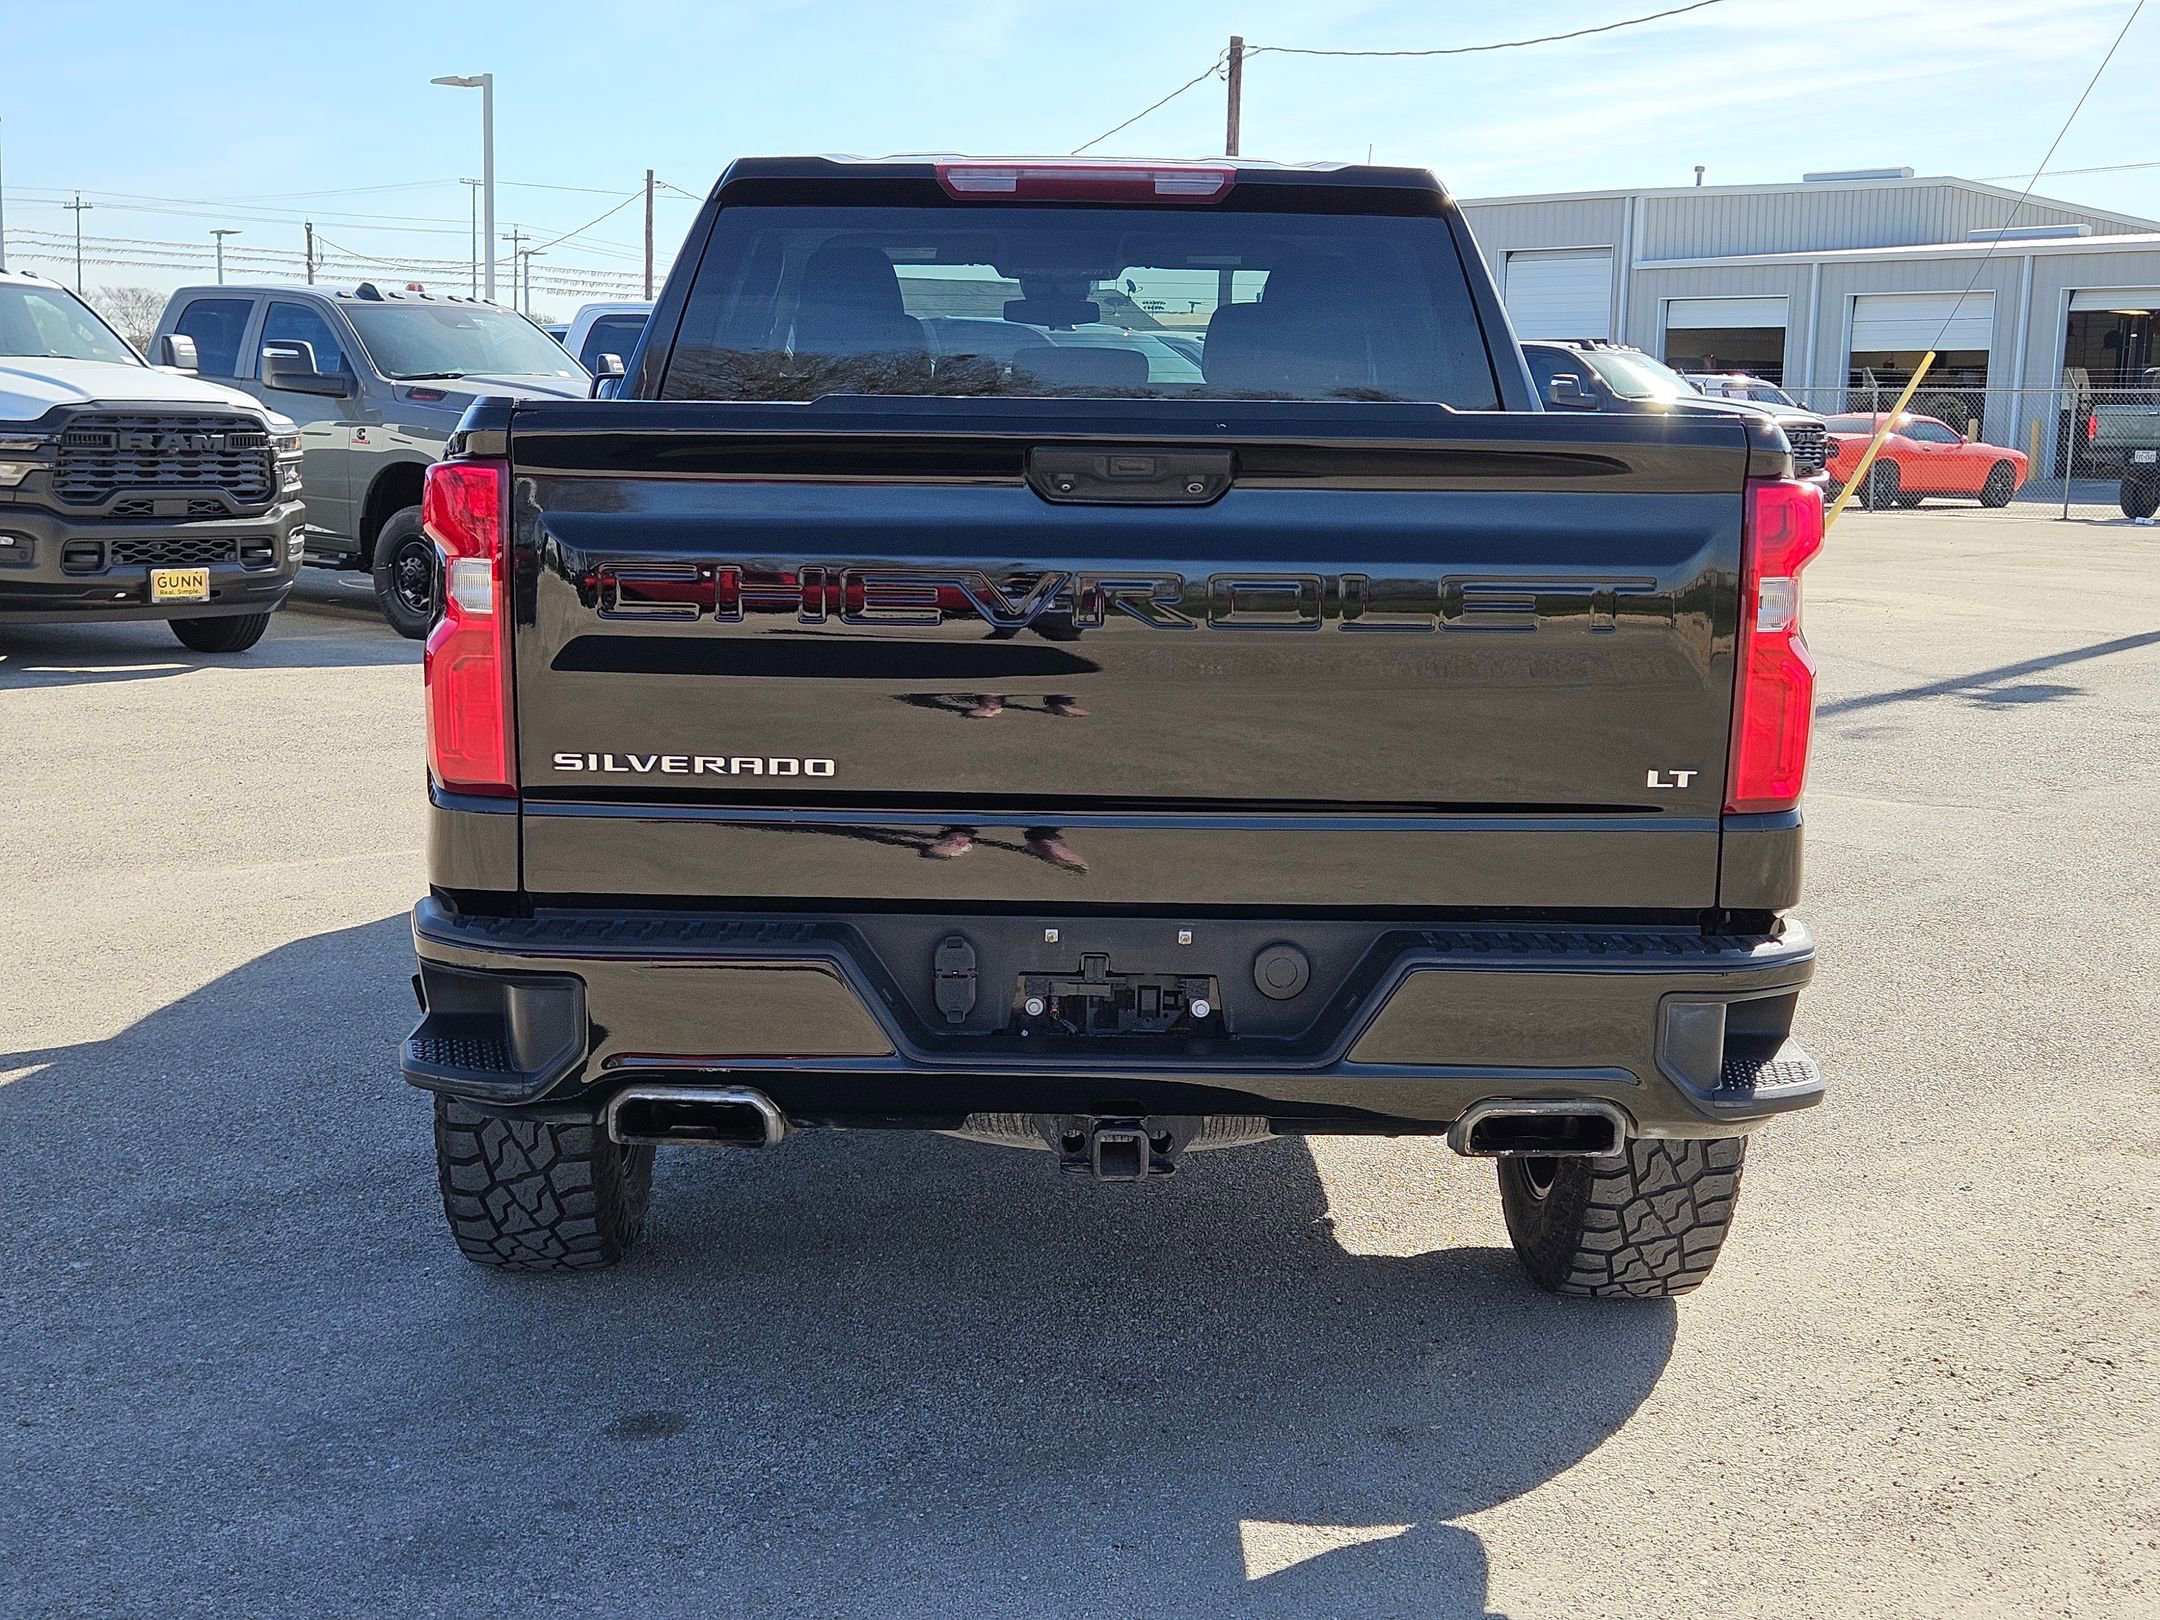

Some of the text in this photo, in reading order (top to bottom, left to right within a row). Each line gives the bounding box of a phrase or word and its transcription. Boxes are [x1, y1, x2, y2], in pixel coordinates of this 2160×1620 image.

[119, 432, 225, 450] RAM
[157, 575, 203, 588] GUNN
[599, 563, 1657, 633] CHEVROLET
[552, 752, 837, 778] SILVERADO
[1646, 768, 1698, 788] LT
